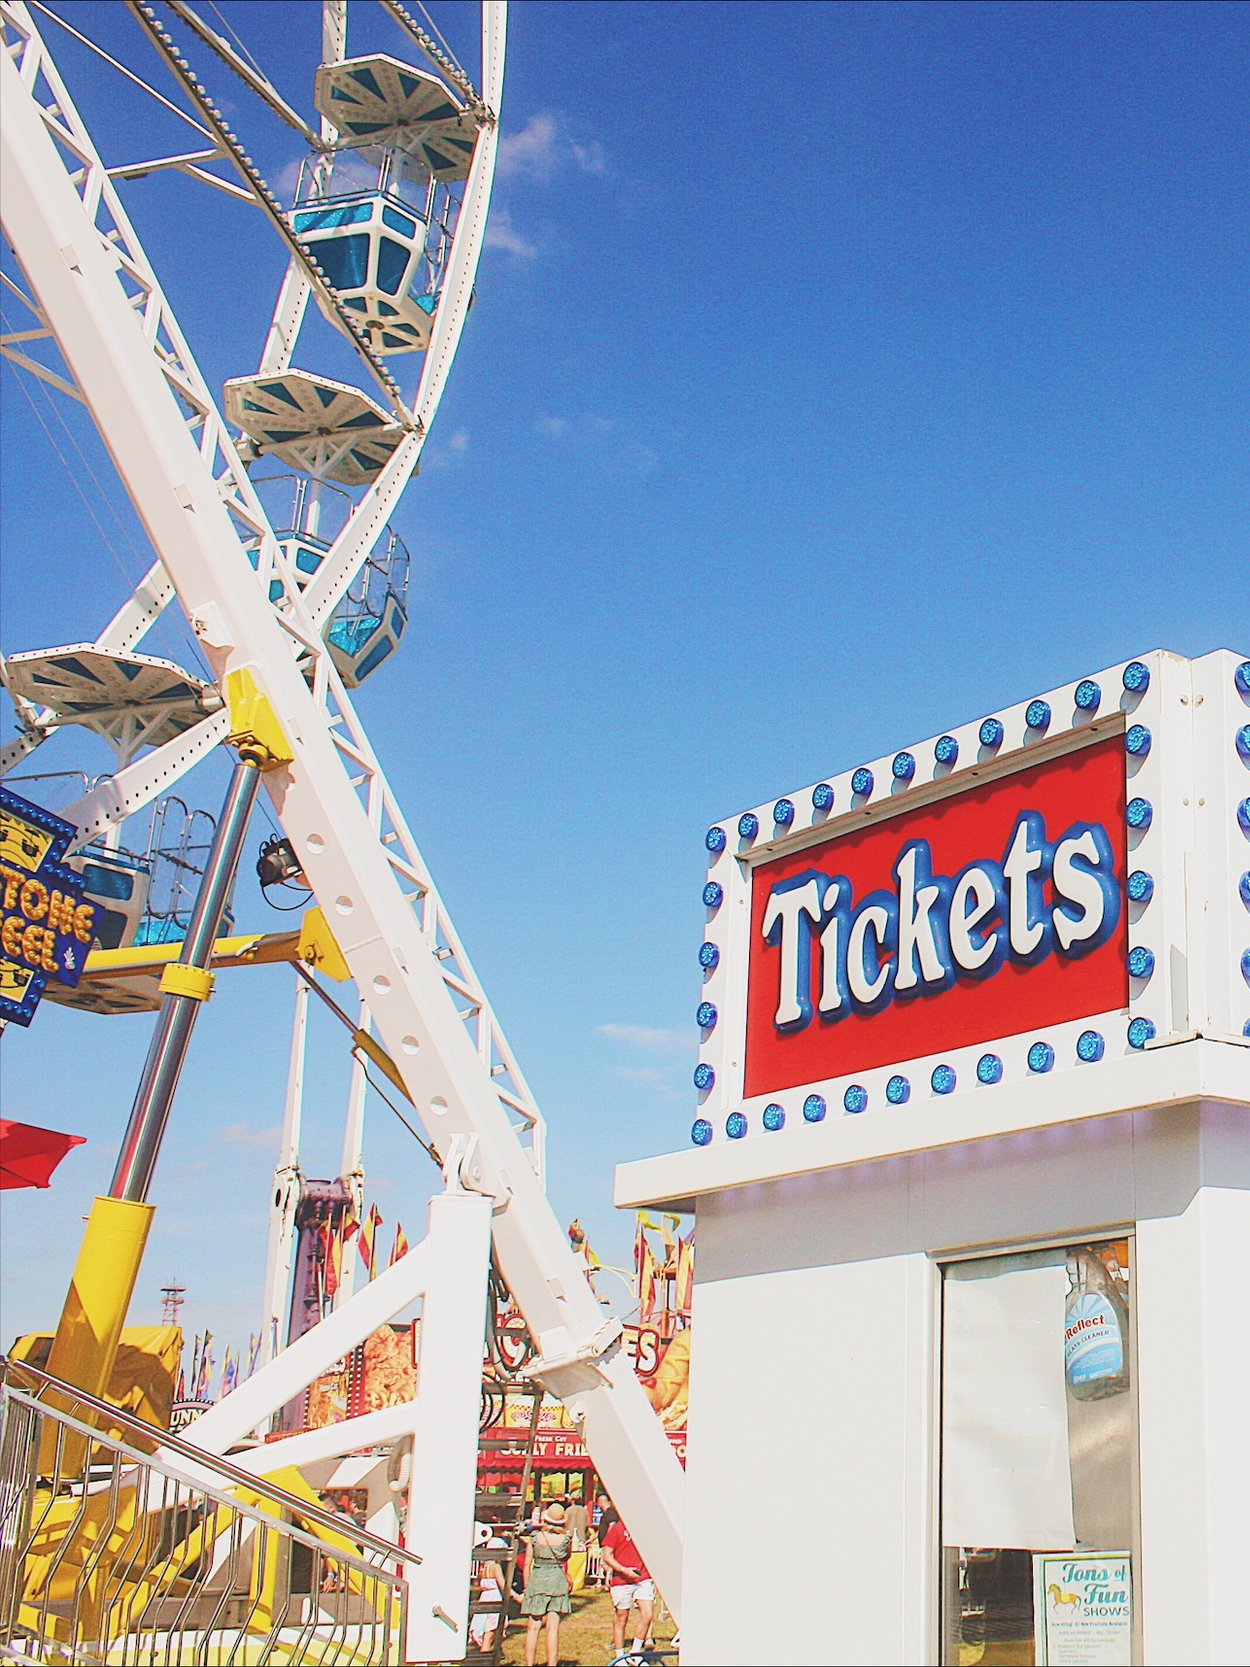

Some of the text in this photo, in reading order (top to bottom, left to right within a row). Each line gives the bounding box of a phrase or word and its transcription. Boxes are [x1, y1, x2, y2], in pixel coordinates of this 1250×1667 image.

[0, 863, 95, 944] TONE
[762, 814, 1110, 1026] Tickets
[0, 908, 59, 973] EEL
[1065, 1315, 1105, 1340] Reflect
[1081, 1330, 1110, 1343] CLEANER
[1062, 1562, 1126, 1583] Tons of
[1084, 1583, 1128, 1605] Fun
[1083, 1607, 1130, 1617] SHOWS
